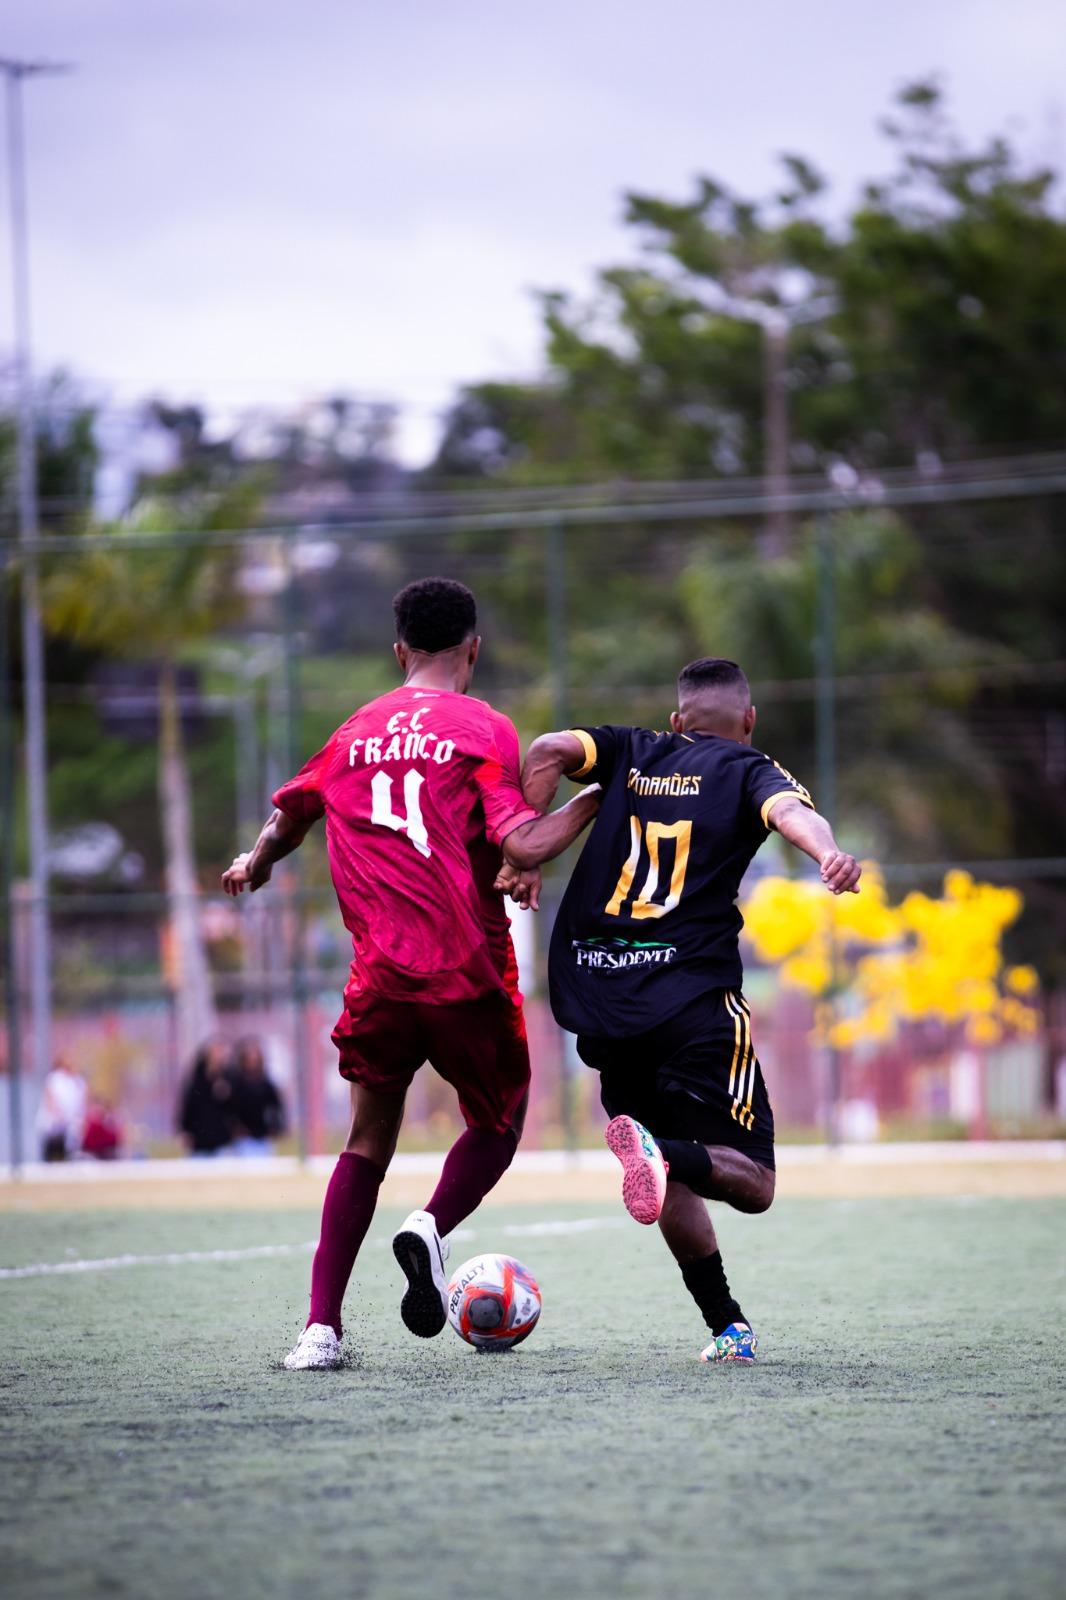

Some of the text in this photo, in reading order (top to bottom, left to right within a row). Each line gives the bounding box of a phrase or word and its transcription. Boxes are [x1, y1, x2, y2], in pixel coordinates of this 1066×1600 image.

[349, 732, 456, 767] FRANCO
[371, 768, 431, 859] 4
[604, 815, 693, 919] 10
[449, 1262, 485, 1315] PENALTY
